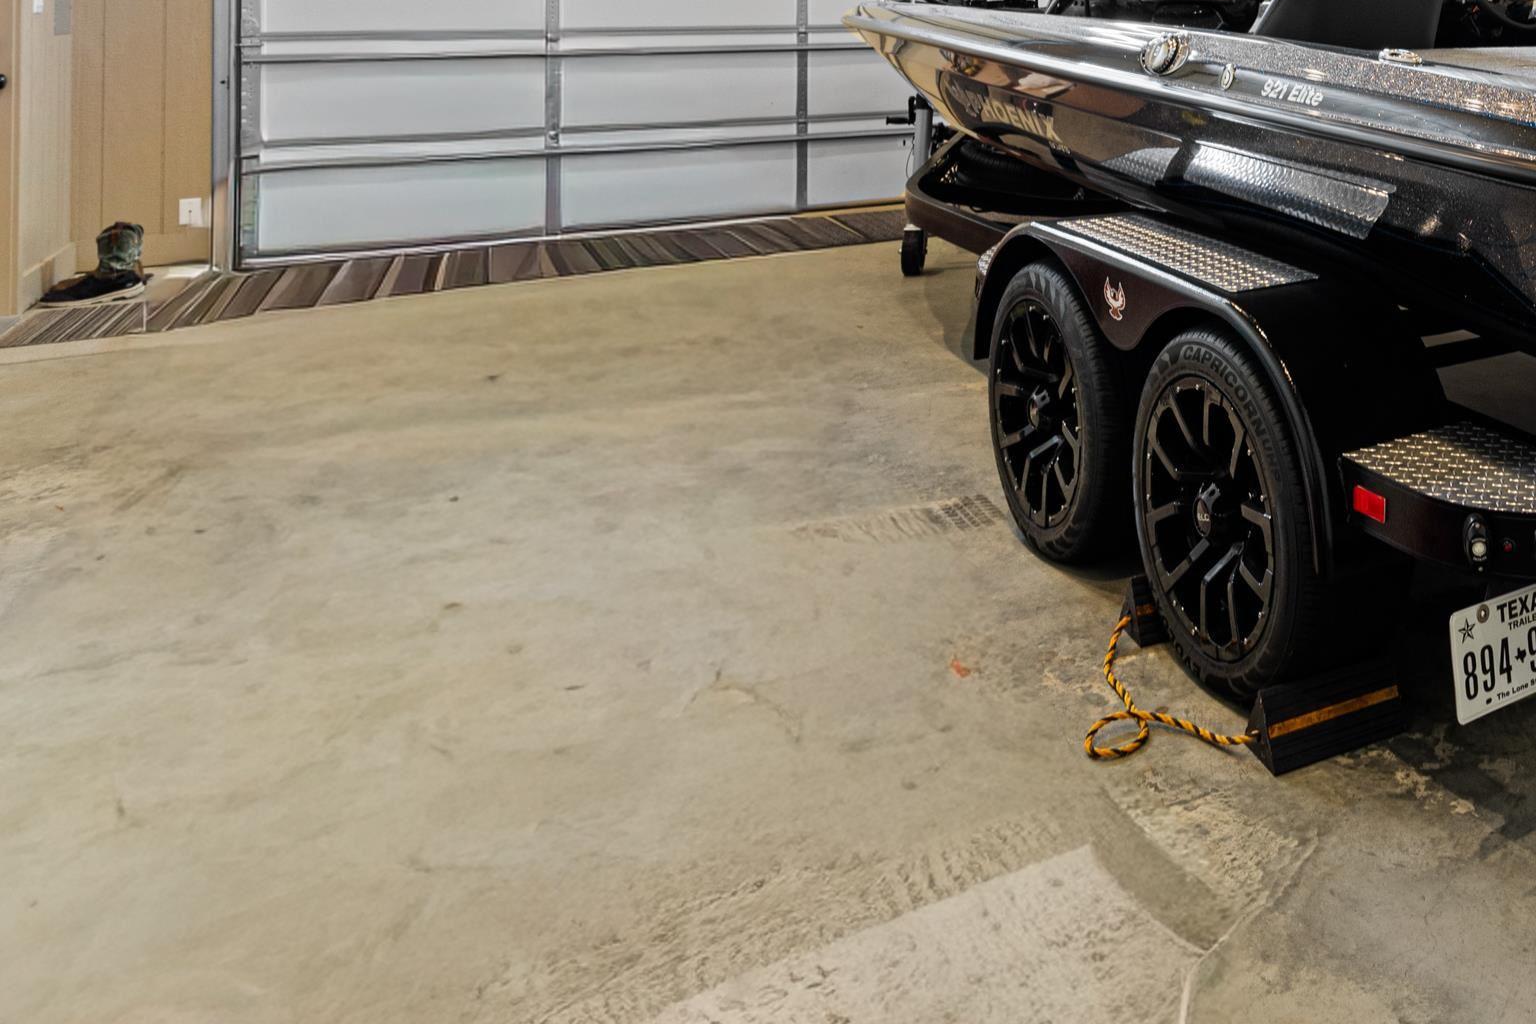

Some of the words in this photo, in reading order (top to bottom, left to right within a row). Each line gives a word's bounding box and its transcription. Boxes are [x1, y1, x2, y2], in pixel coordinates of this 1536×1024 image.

[1261, 78, 1290, 100] 921
[1287, 83, 1324, 107] Elite
[1463, 637, 1513, 701] 894
[1497, 689, 1510, 701] The
[1512, 682, 1529, 695] Lone
